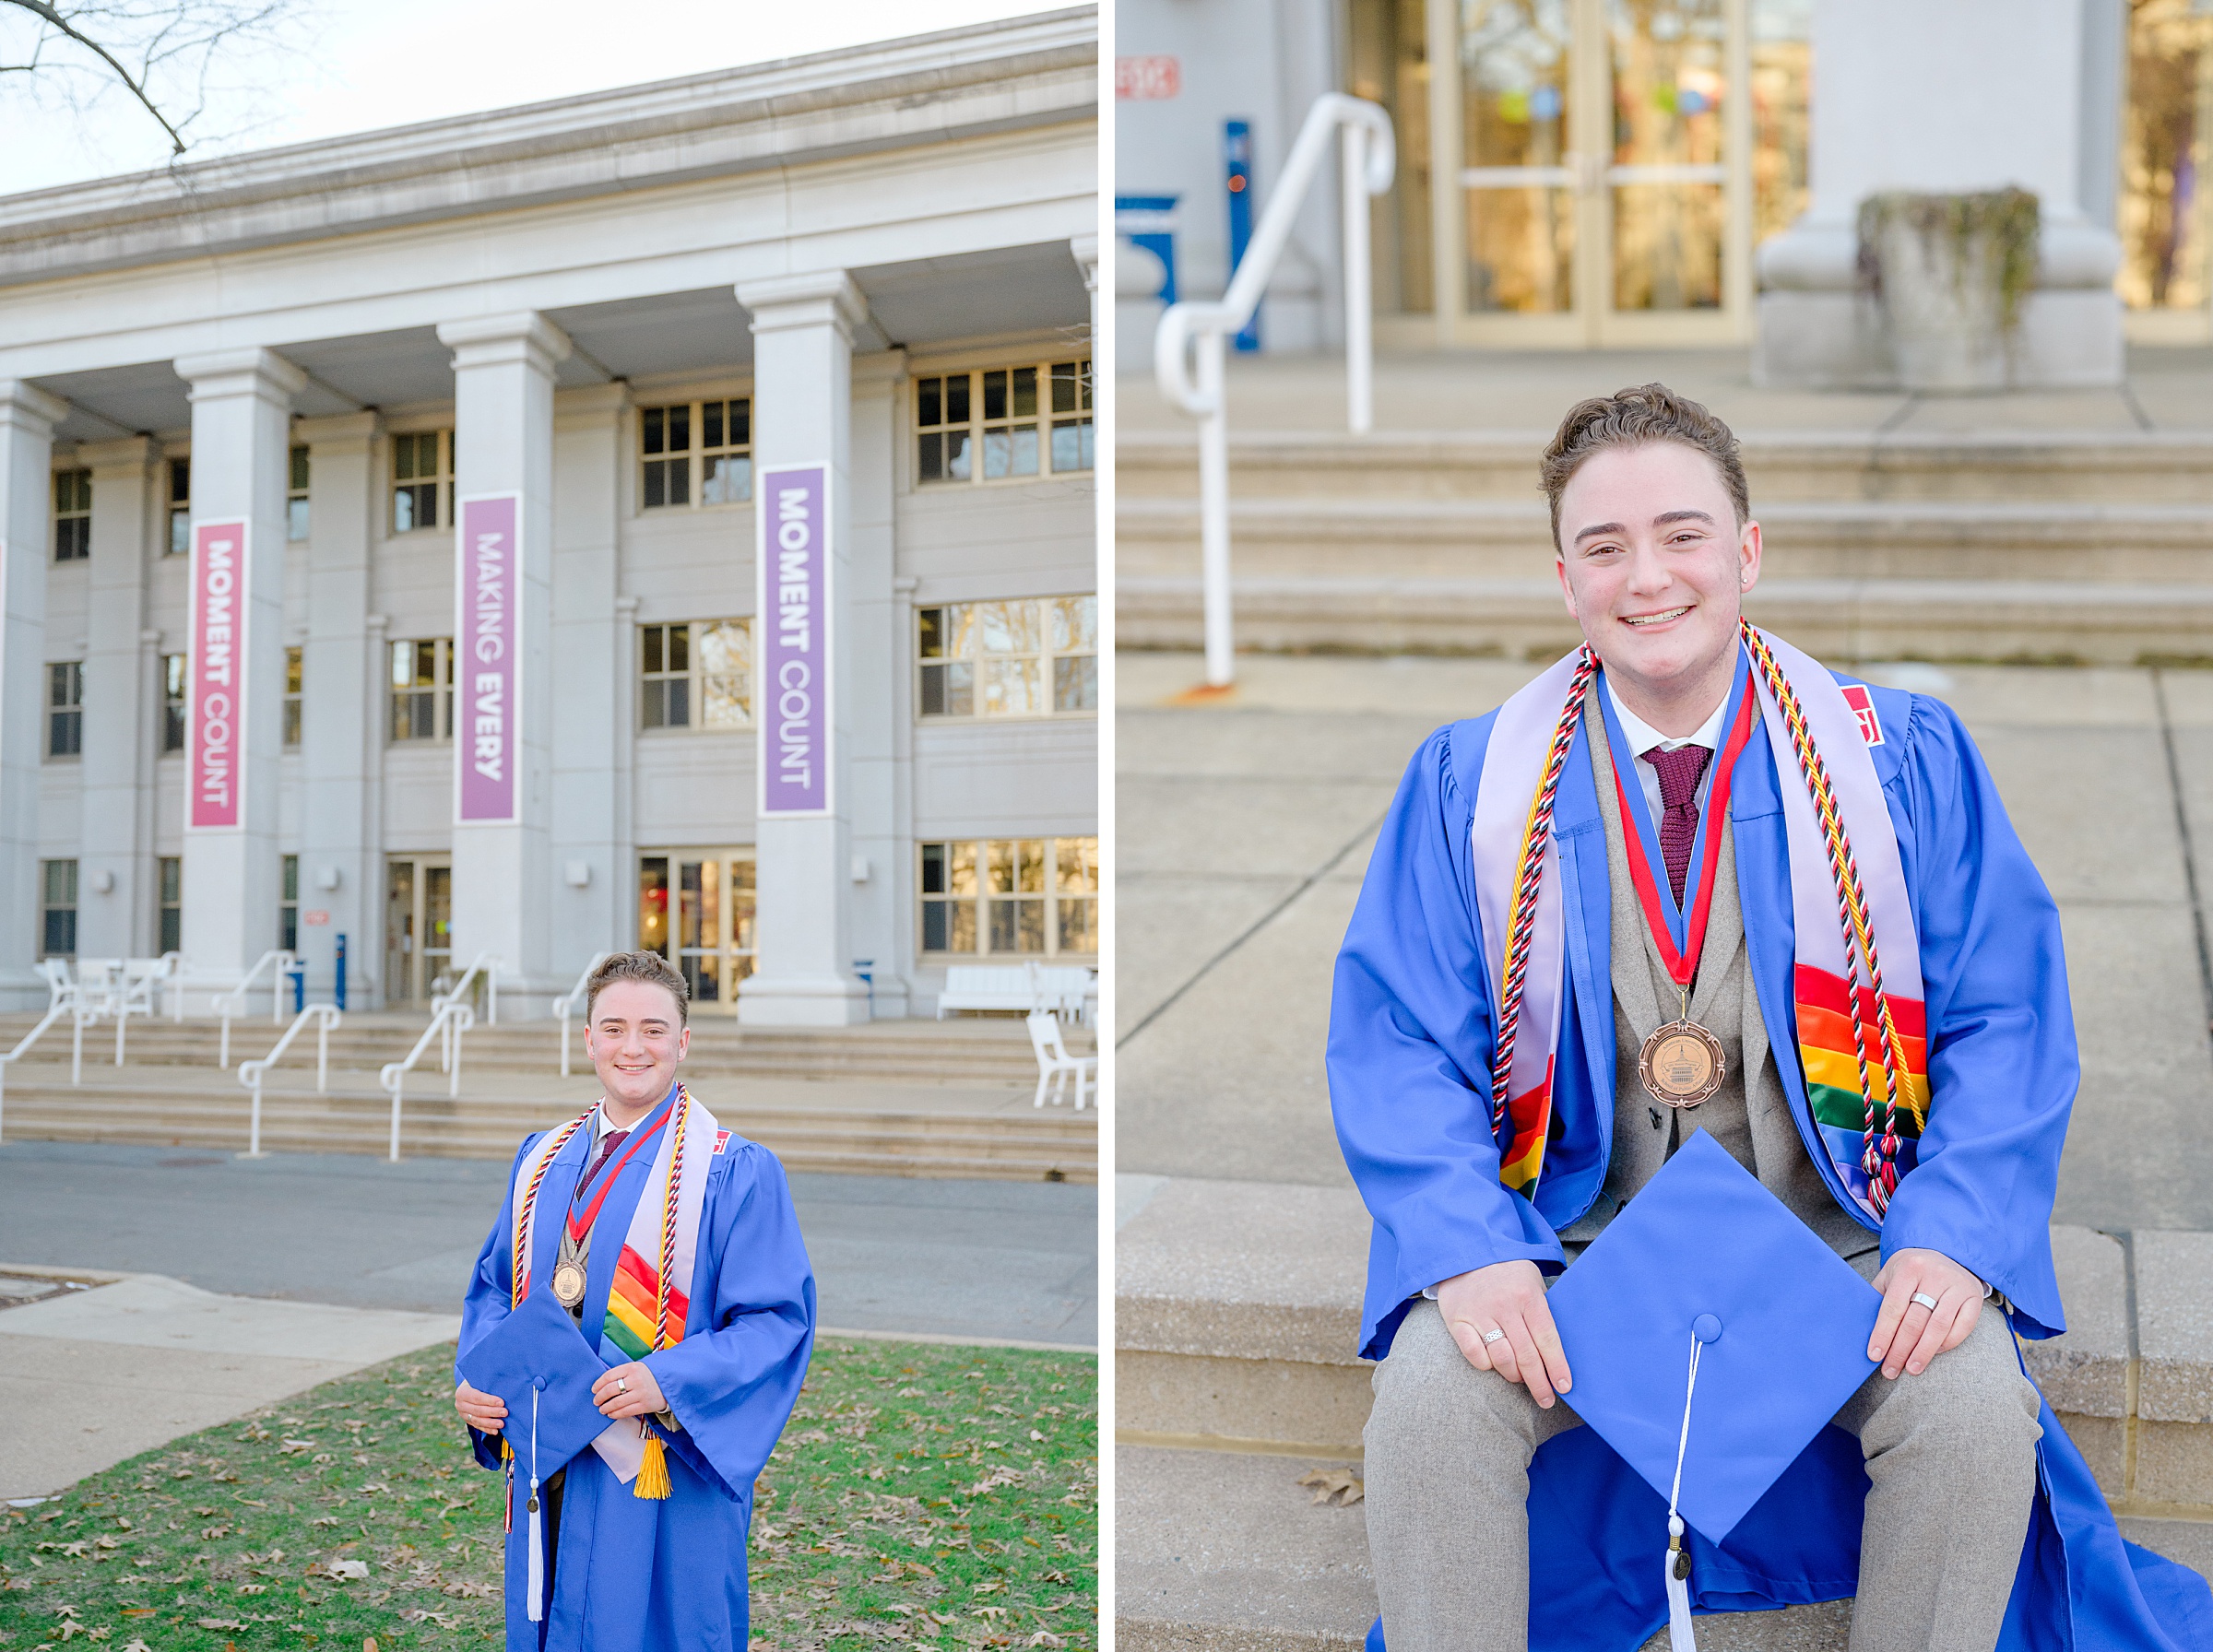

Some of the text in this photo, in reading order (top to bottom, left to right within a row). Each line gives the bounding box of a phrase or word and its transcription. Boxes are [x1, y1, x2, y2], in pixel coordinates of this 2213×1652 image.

[203, 539, 233, 809] MOMENT COUNT
[475, 532, 505, 784] MAKING EVERY
[778, 487, 811, 790] MOMENT COUNT
